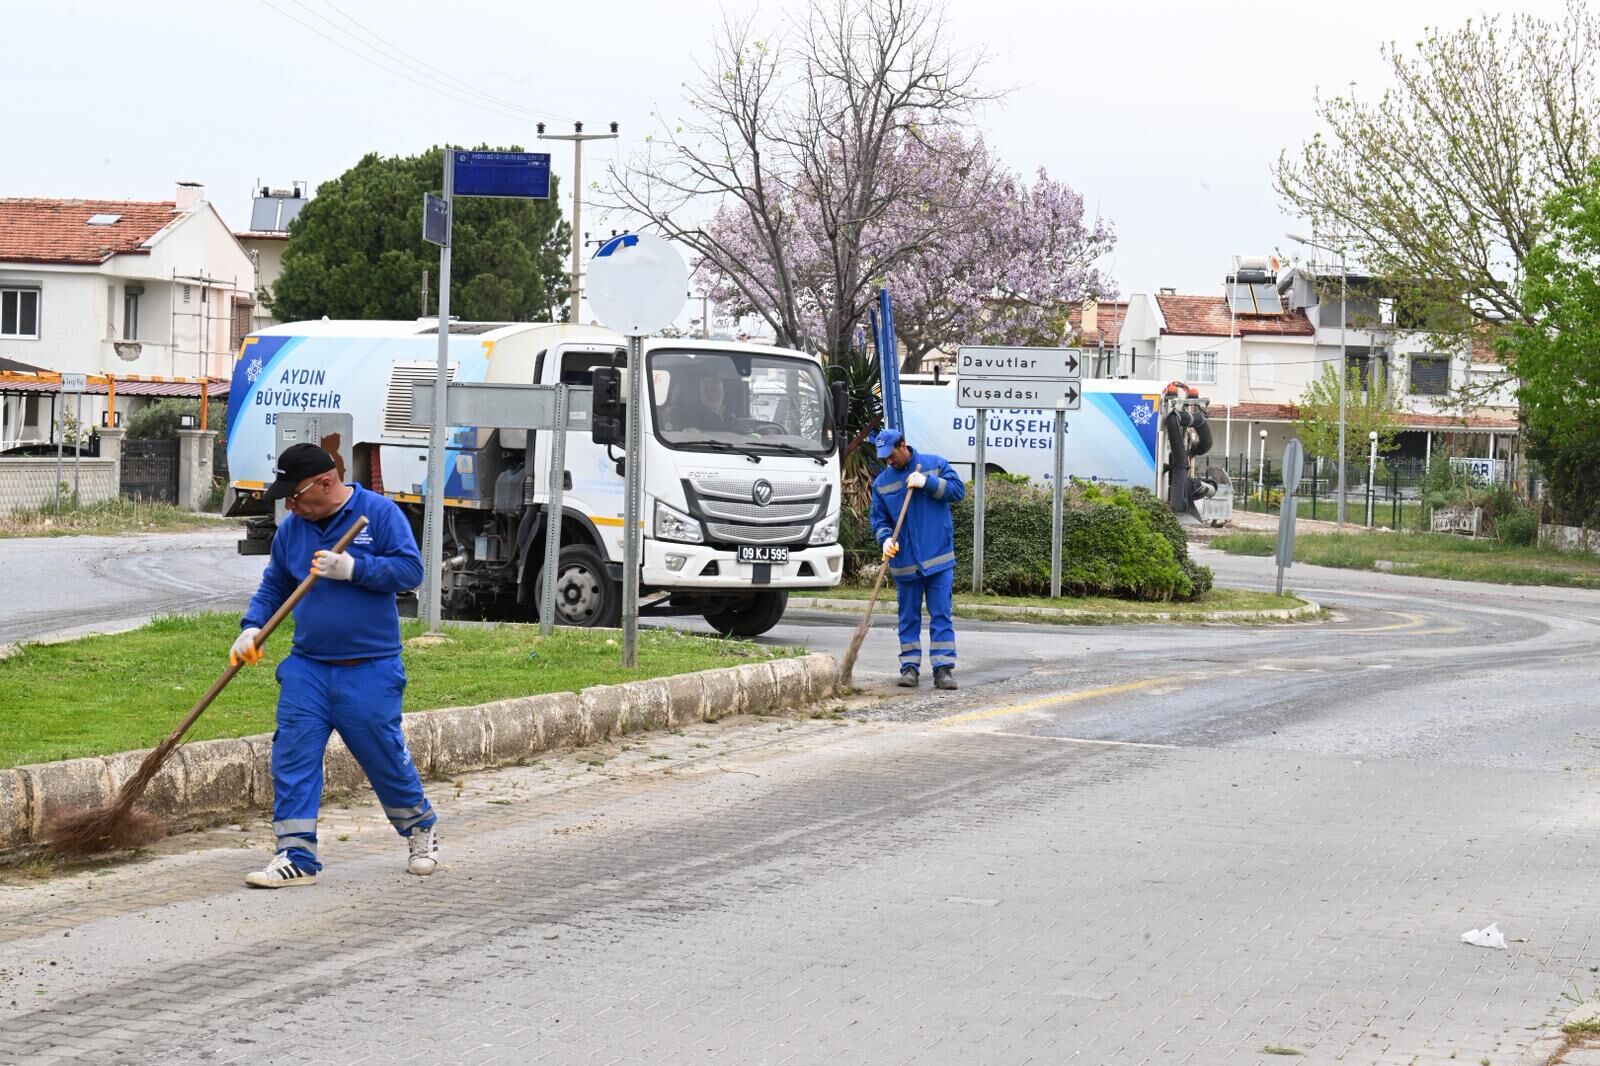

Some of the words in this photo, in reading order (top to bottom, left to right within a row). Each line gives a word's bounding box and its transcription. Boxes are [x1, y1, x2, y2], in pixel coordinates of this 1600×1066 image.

[963, 356, 1036, 368] Davutlar
[280, 369, 326, 385] AYDIN
[256, 388, 341, 411] BÜYÜKŞEHİR
[962, 387, 1038, 400] Kuşadası
[968, 435, 1053, 449] BLEDİYESİ
[742, 547, 753, 560] 09
[755, 548, 769, 560] KJ
[770, 549, 787, 560] 595
